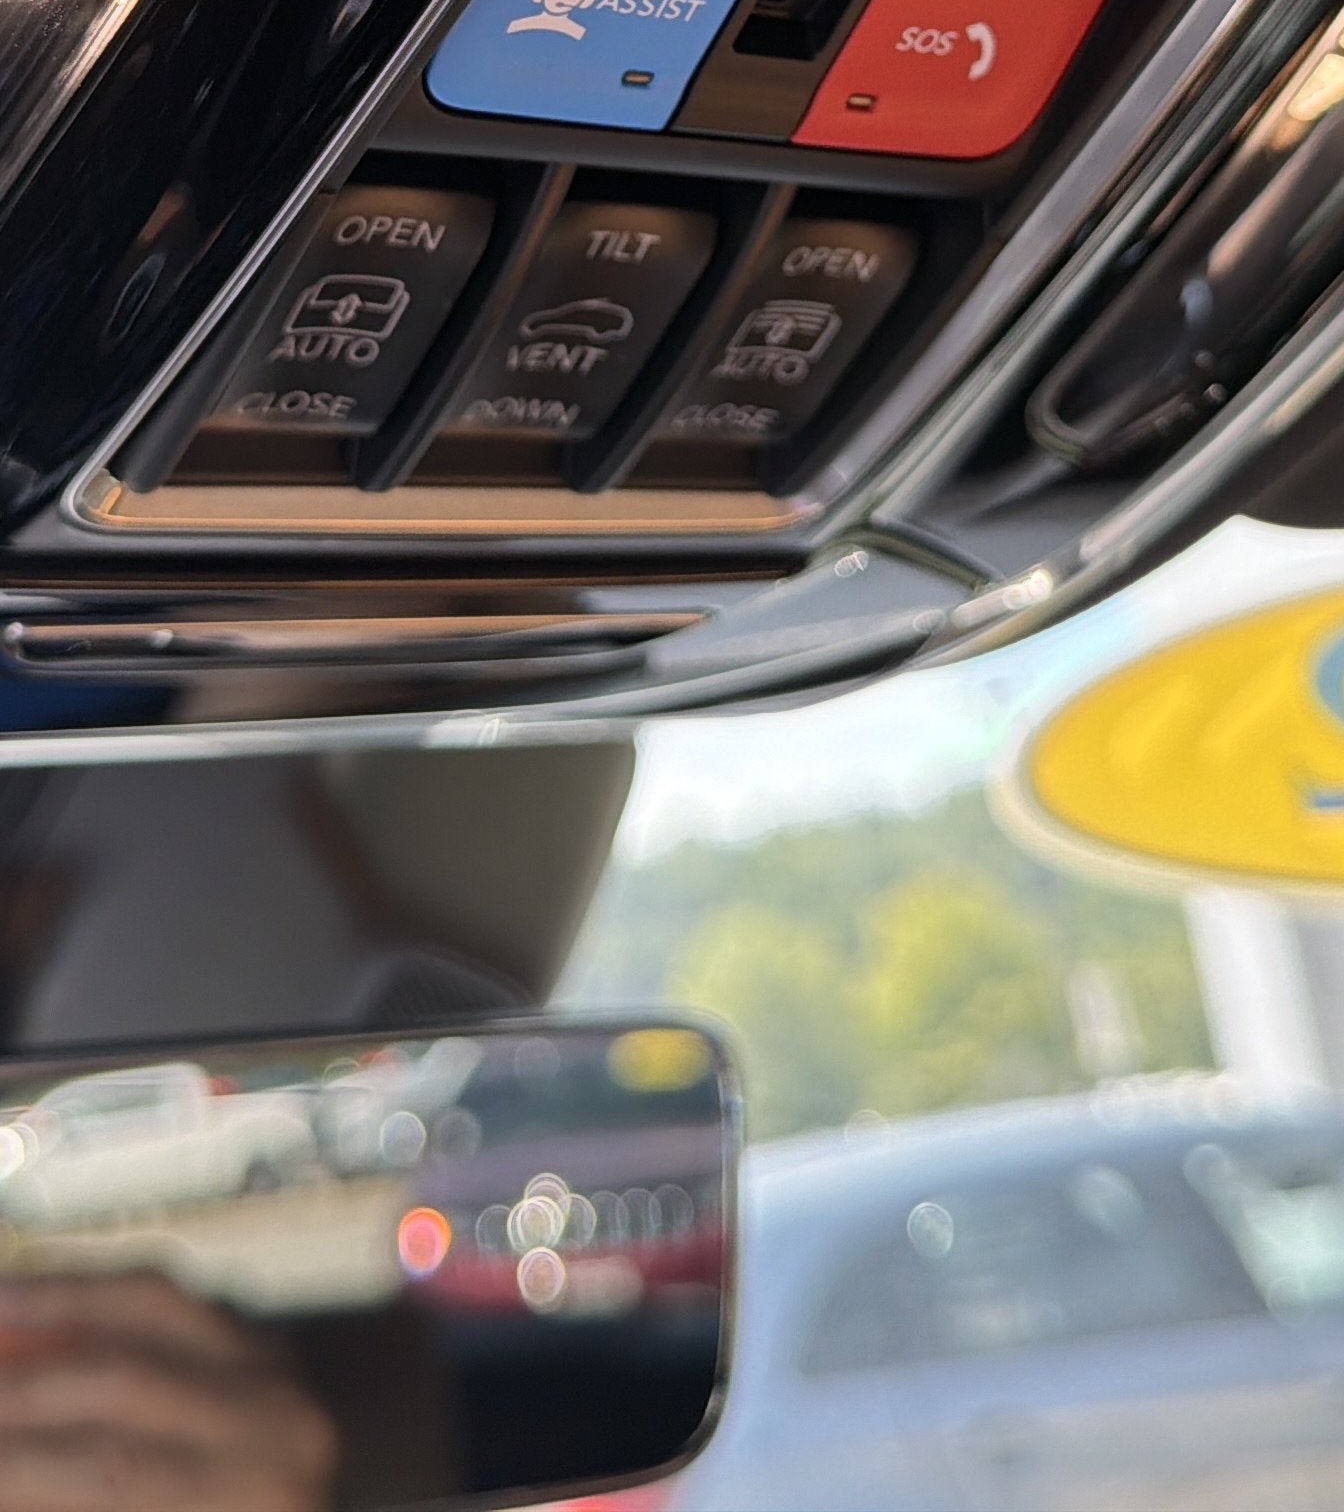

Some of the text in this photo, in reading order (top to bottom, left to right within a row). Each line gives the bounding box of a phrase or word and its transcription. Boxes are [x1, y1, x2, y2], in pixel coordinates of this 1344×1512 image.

[895, 25, 959, 55] SOS
[336, 215, 446, 253] OPEN
[586, 229, 661, 262] TILT
[782, 245, 881, 282] OPEN
[266, 335, 380, 366] AUTO
[507, 342, 608, 375] VENT
[710, 350, 810, 385] AUTO
[236, 389, 356, 418] CLOSE
[459, 396, 581, 426] DOWN
[671, 402, 780, 431] CLOSE
